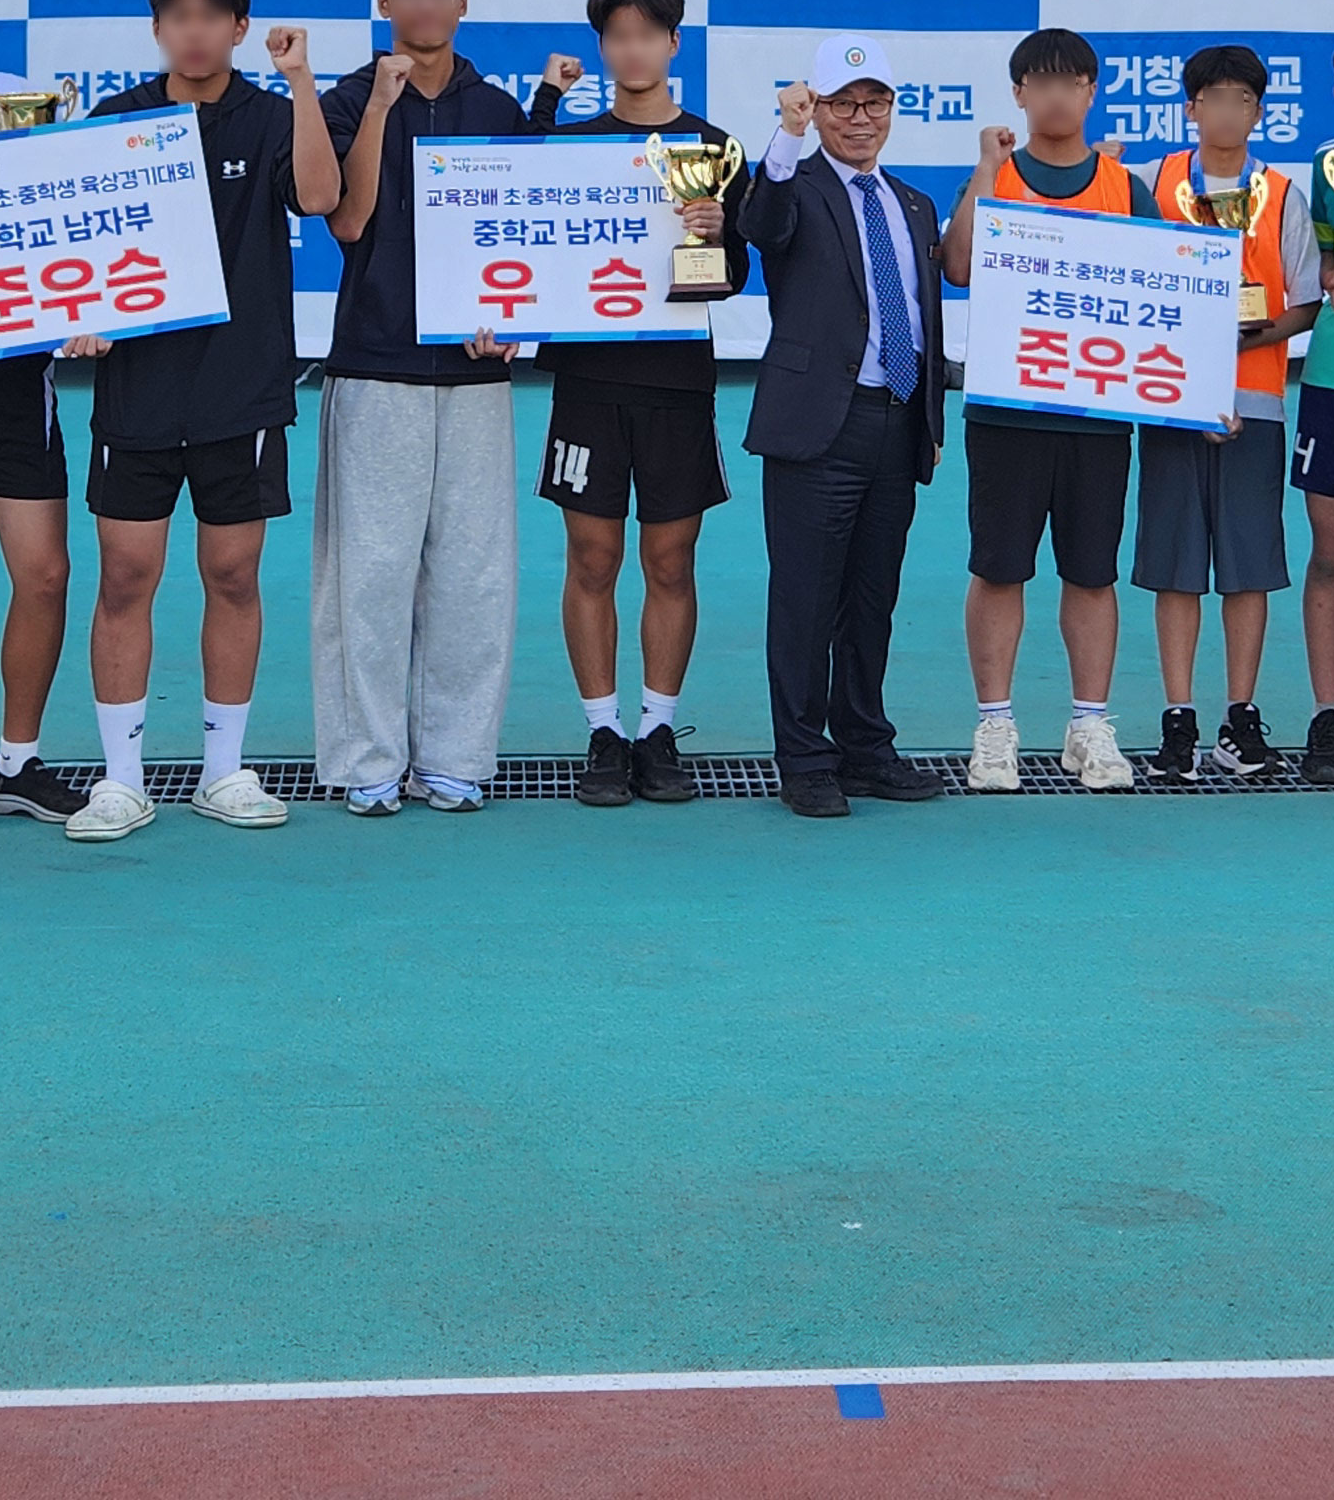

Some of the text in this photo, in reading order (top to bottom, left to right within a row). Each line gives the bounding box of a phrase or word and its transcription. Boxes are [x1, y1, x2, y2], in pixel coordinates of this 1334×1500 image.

[1104, 56, 1303, 99] 거창교
[1104, 102, 1304, 144] 고제장
[81, 161, 195, 193] 육상경기대회
[427, 189, 497, 206] 교육장배
[585, 185, 675, 205] 육상경기
[63, 201, 153, 245] 남자부
[474, 218, 648, 247] 중학교 남자부
[479, 261, 537, 318] 우
[589, 258, 646, 318] 승
[982, 251, 1049, 275] 교육장배
[1131, 269, 1229, 298] 육상경기대회
[1026, 287, 1181, 331] 초등학교 2부
[1015, 327, 1186, 404] 준우승
[552, 440, 590, 493] 14
